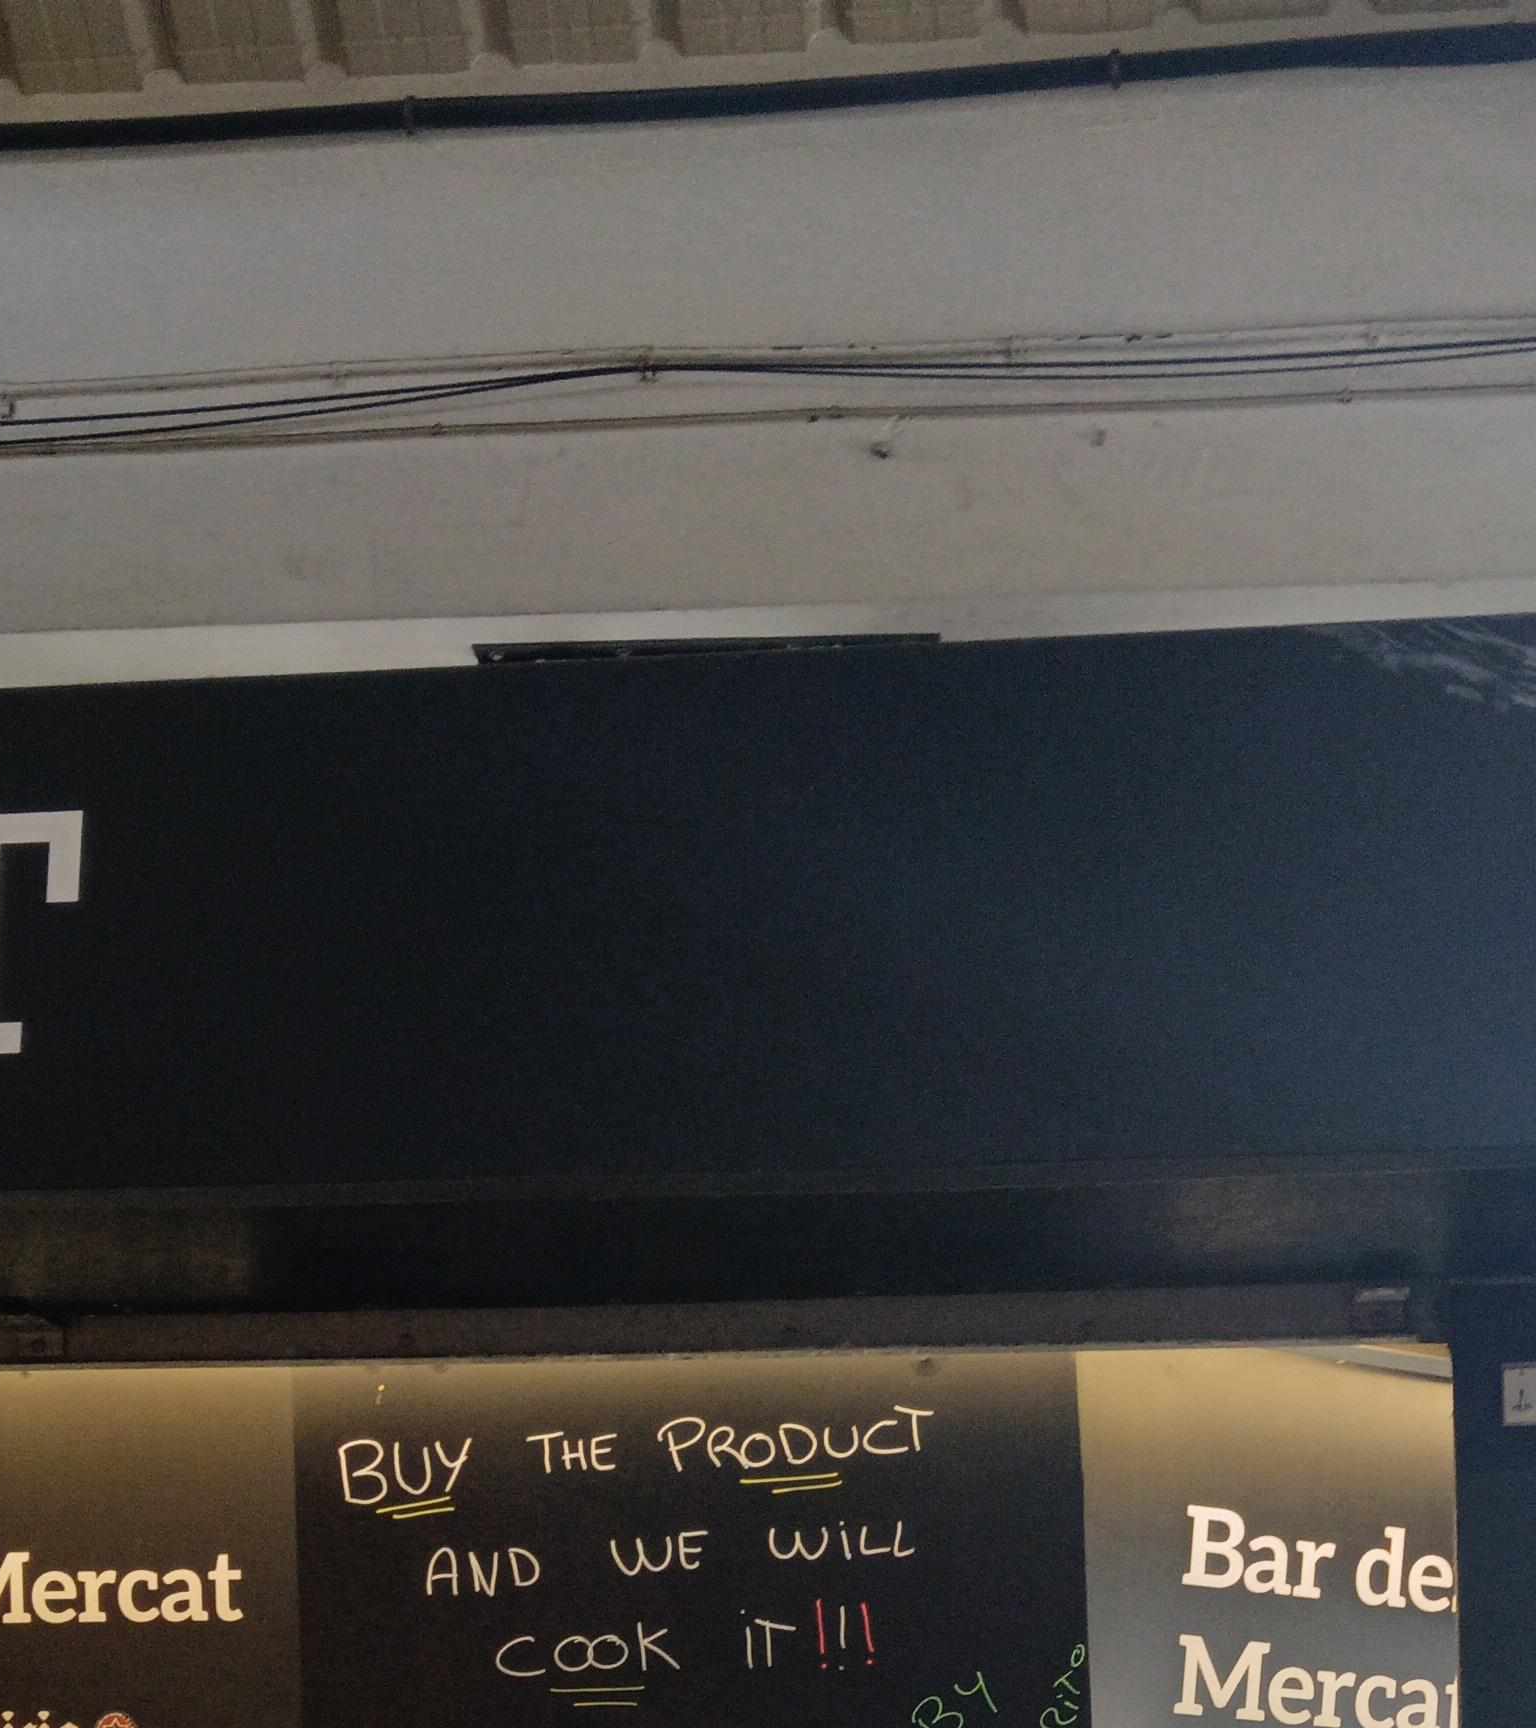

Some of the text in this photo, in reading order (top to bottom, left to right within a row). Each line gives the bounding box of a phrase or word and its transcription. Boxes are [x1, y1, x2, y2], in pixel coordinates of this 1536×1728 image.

[338, 1405, 934, 1506] BUY THE PRODUCT
[426, 1545, 540, 1598] AND
[611, 1529, 710, 1577] WE
[1181, 1504, 1458, 1613] Bar de
[495, 1623, 682, 1678] COOK
